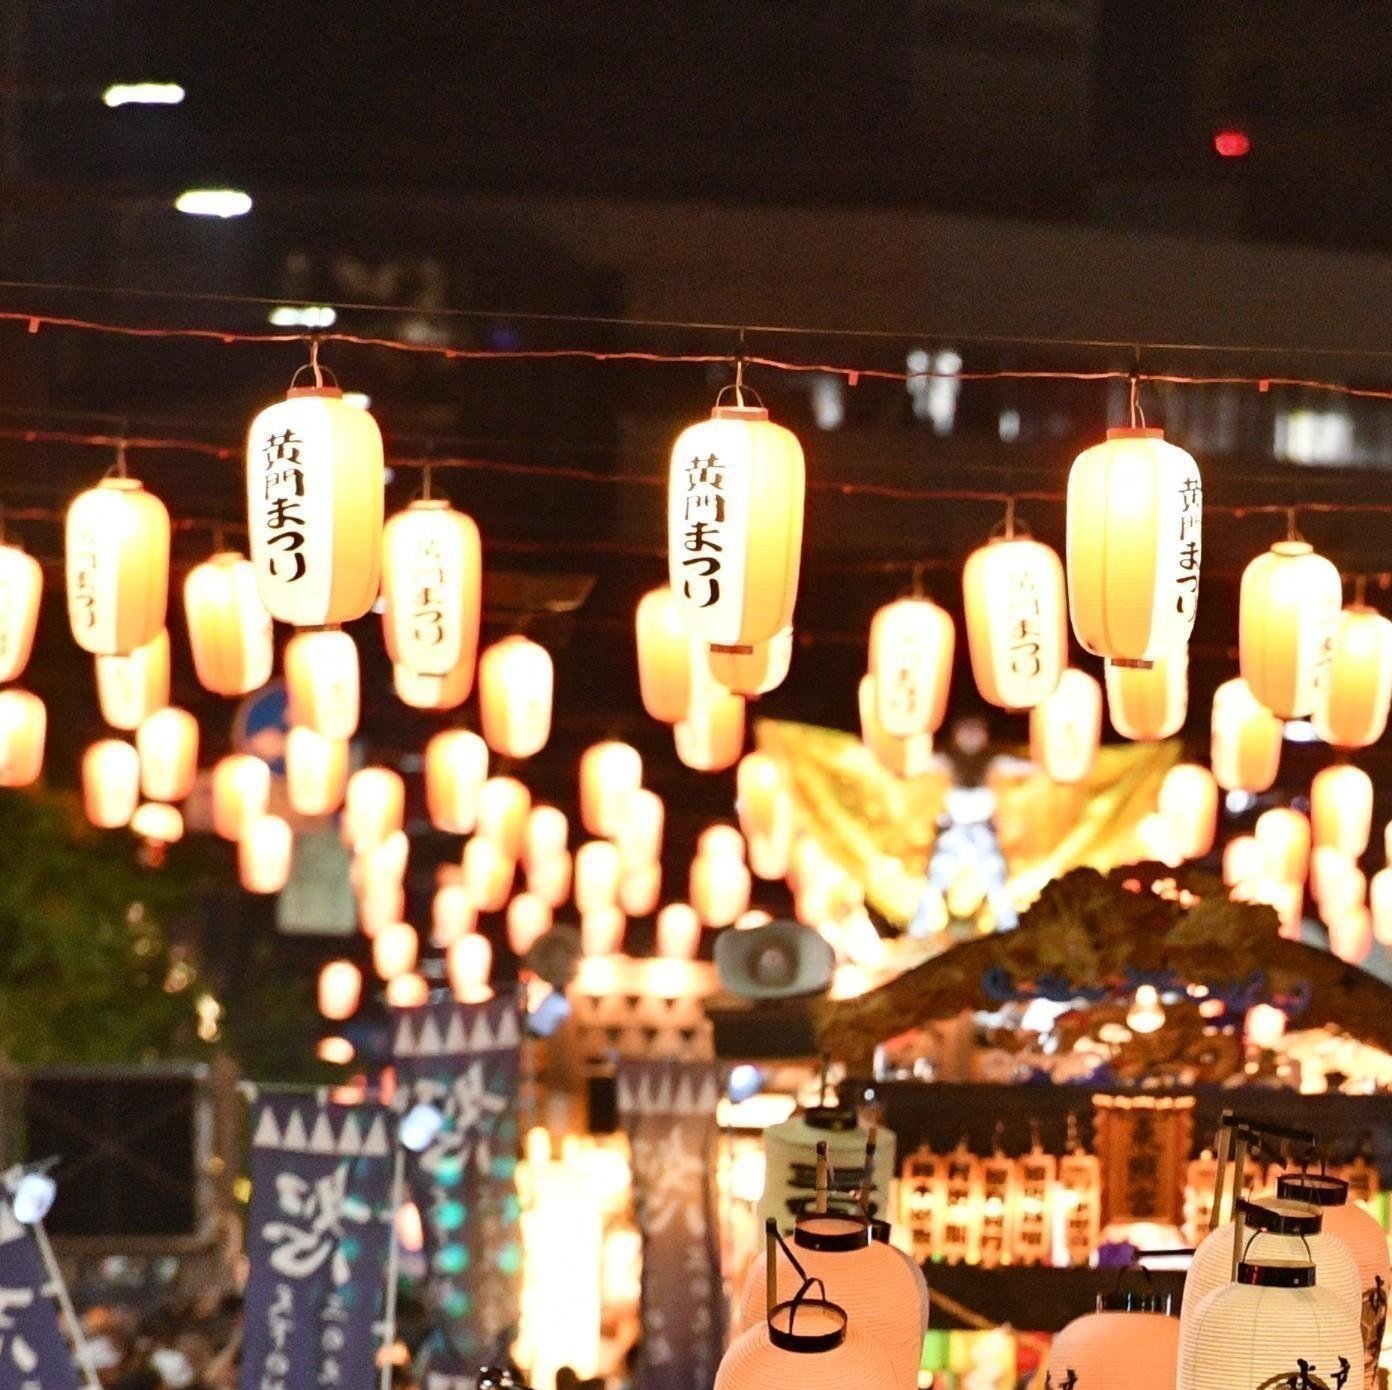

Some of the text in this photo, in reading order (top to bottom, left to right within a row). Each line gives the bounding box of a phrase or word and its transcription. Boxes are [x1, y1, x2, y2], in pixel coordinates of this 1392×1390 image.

[262, 429, 306, 583] 黄門まつり
[682, 454, 726, 608] 黄門まつり
